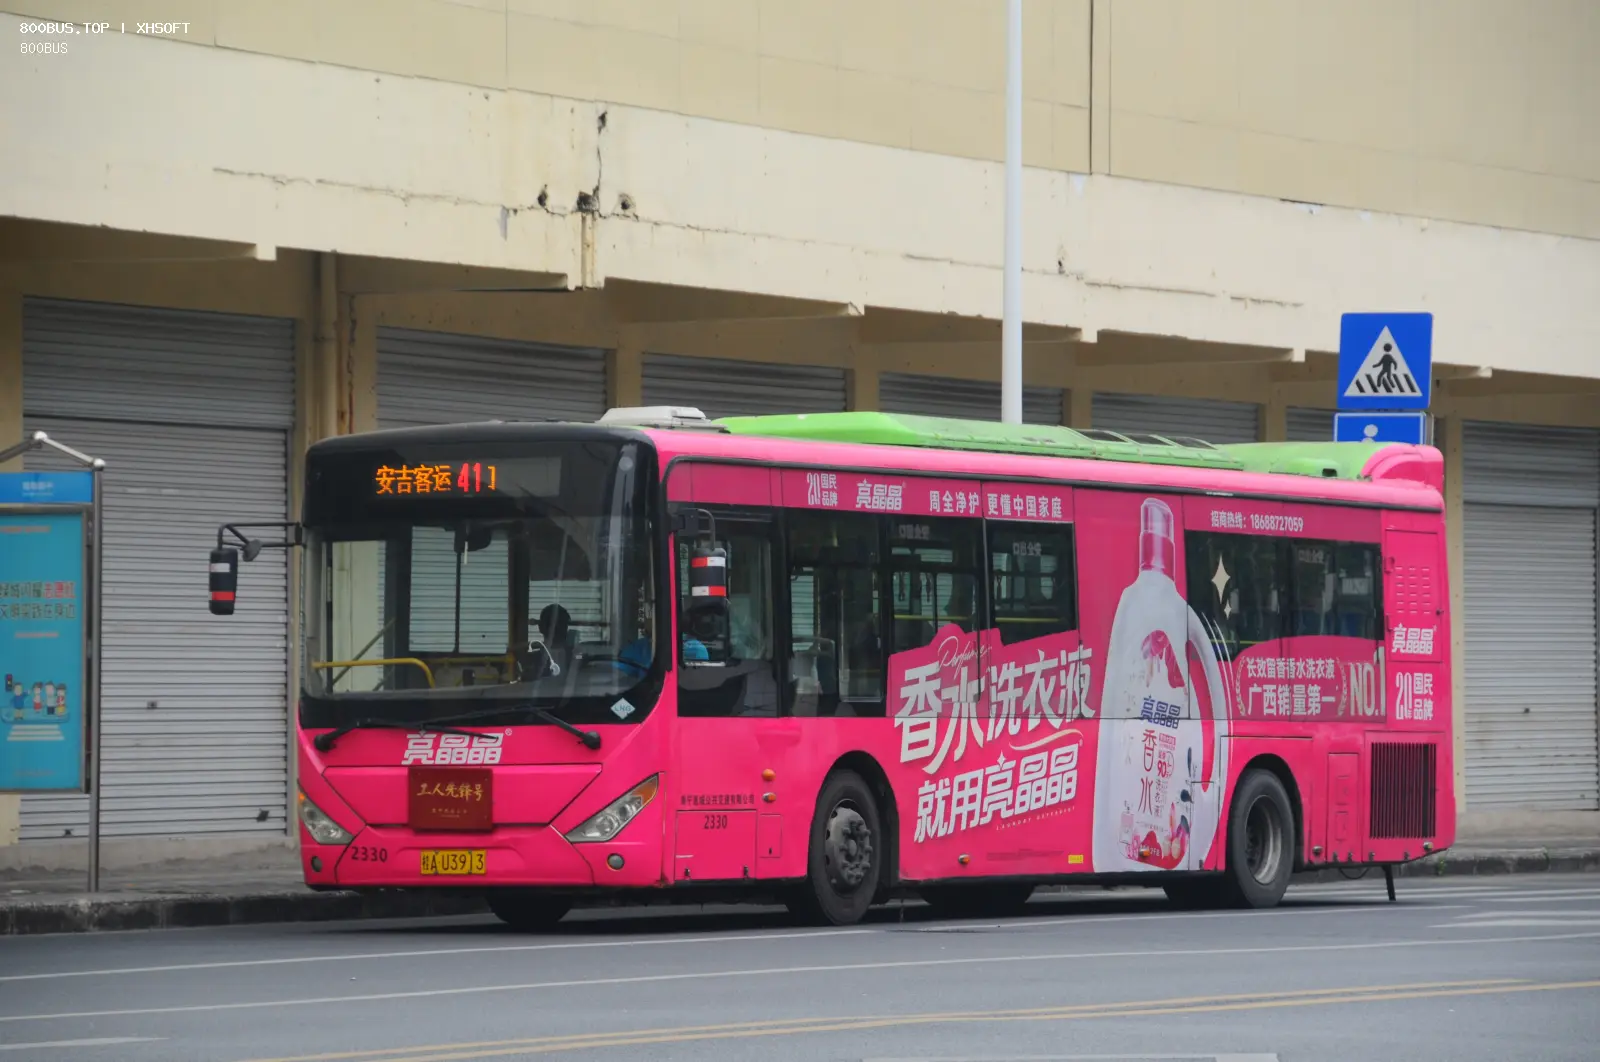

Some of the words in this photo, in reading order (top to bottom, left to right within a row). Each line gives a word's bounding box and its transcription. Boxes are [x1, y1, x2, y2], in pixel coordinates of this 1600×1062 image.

[375, 463, 452, 494] 安吉客运
[457, 462, 482, 493] 41
[855, 478, 903, 511] 亮晶晶
[929, 490, 980, 514] 周全净护
[987, 493, 1062, 519] 更懂中国家庭
[1250, 513, 1305, 532] 18688727059
[1391, 622, 1434, 654] 亮晶晶
[1246, 656, 1335, 680] 长效留香香水洗衣液
[1413, 672, 1434, 695] 国民
[894, 645, 1096, 775] 香水洗衣液
[1140, 695, 1181, 729] 亮晶晶
[1247, 682, 1336, 717] 广西销量第一
[1413, 698, 1434, 720] 品牌
[401, 727, 504, 765] 亮晶晶
[416, 782, 484, 802] 工人先锋号
[912, 742, 1080, 843] 就用亮晶晶
[704, 814, 728, 830] 2330
[351, 846, 389, 863] 2330
